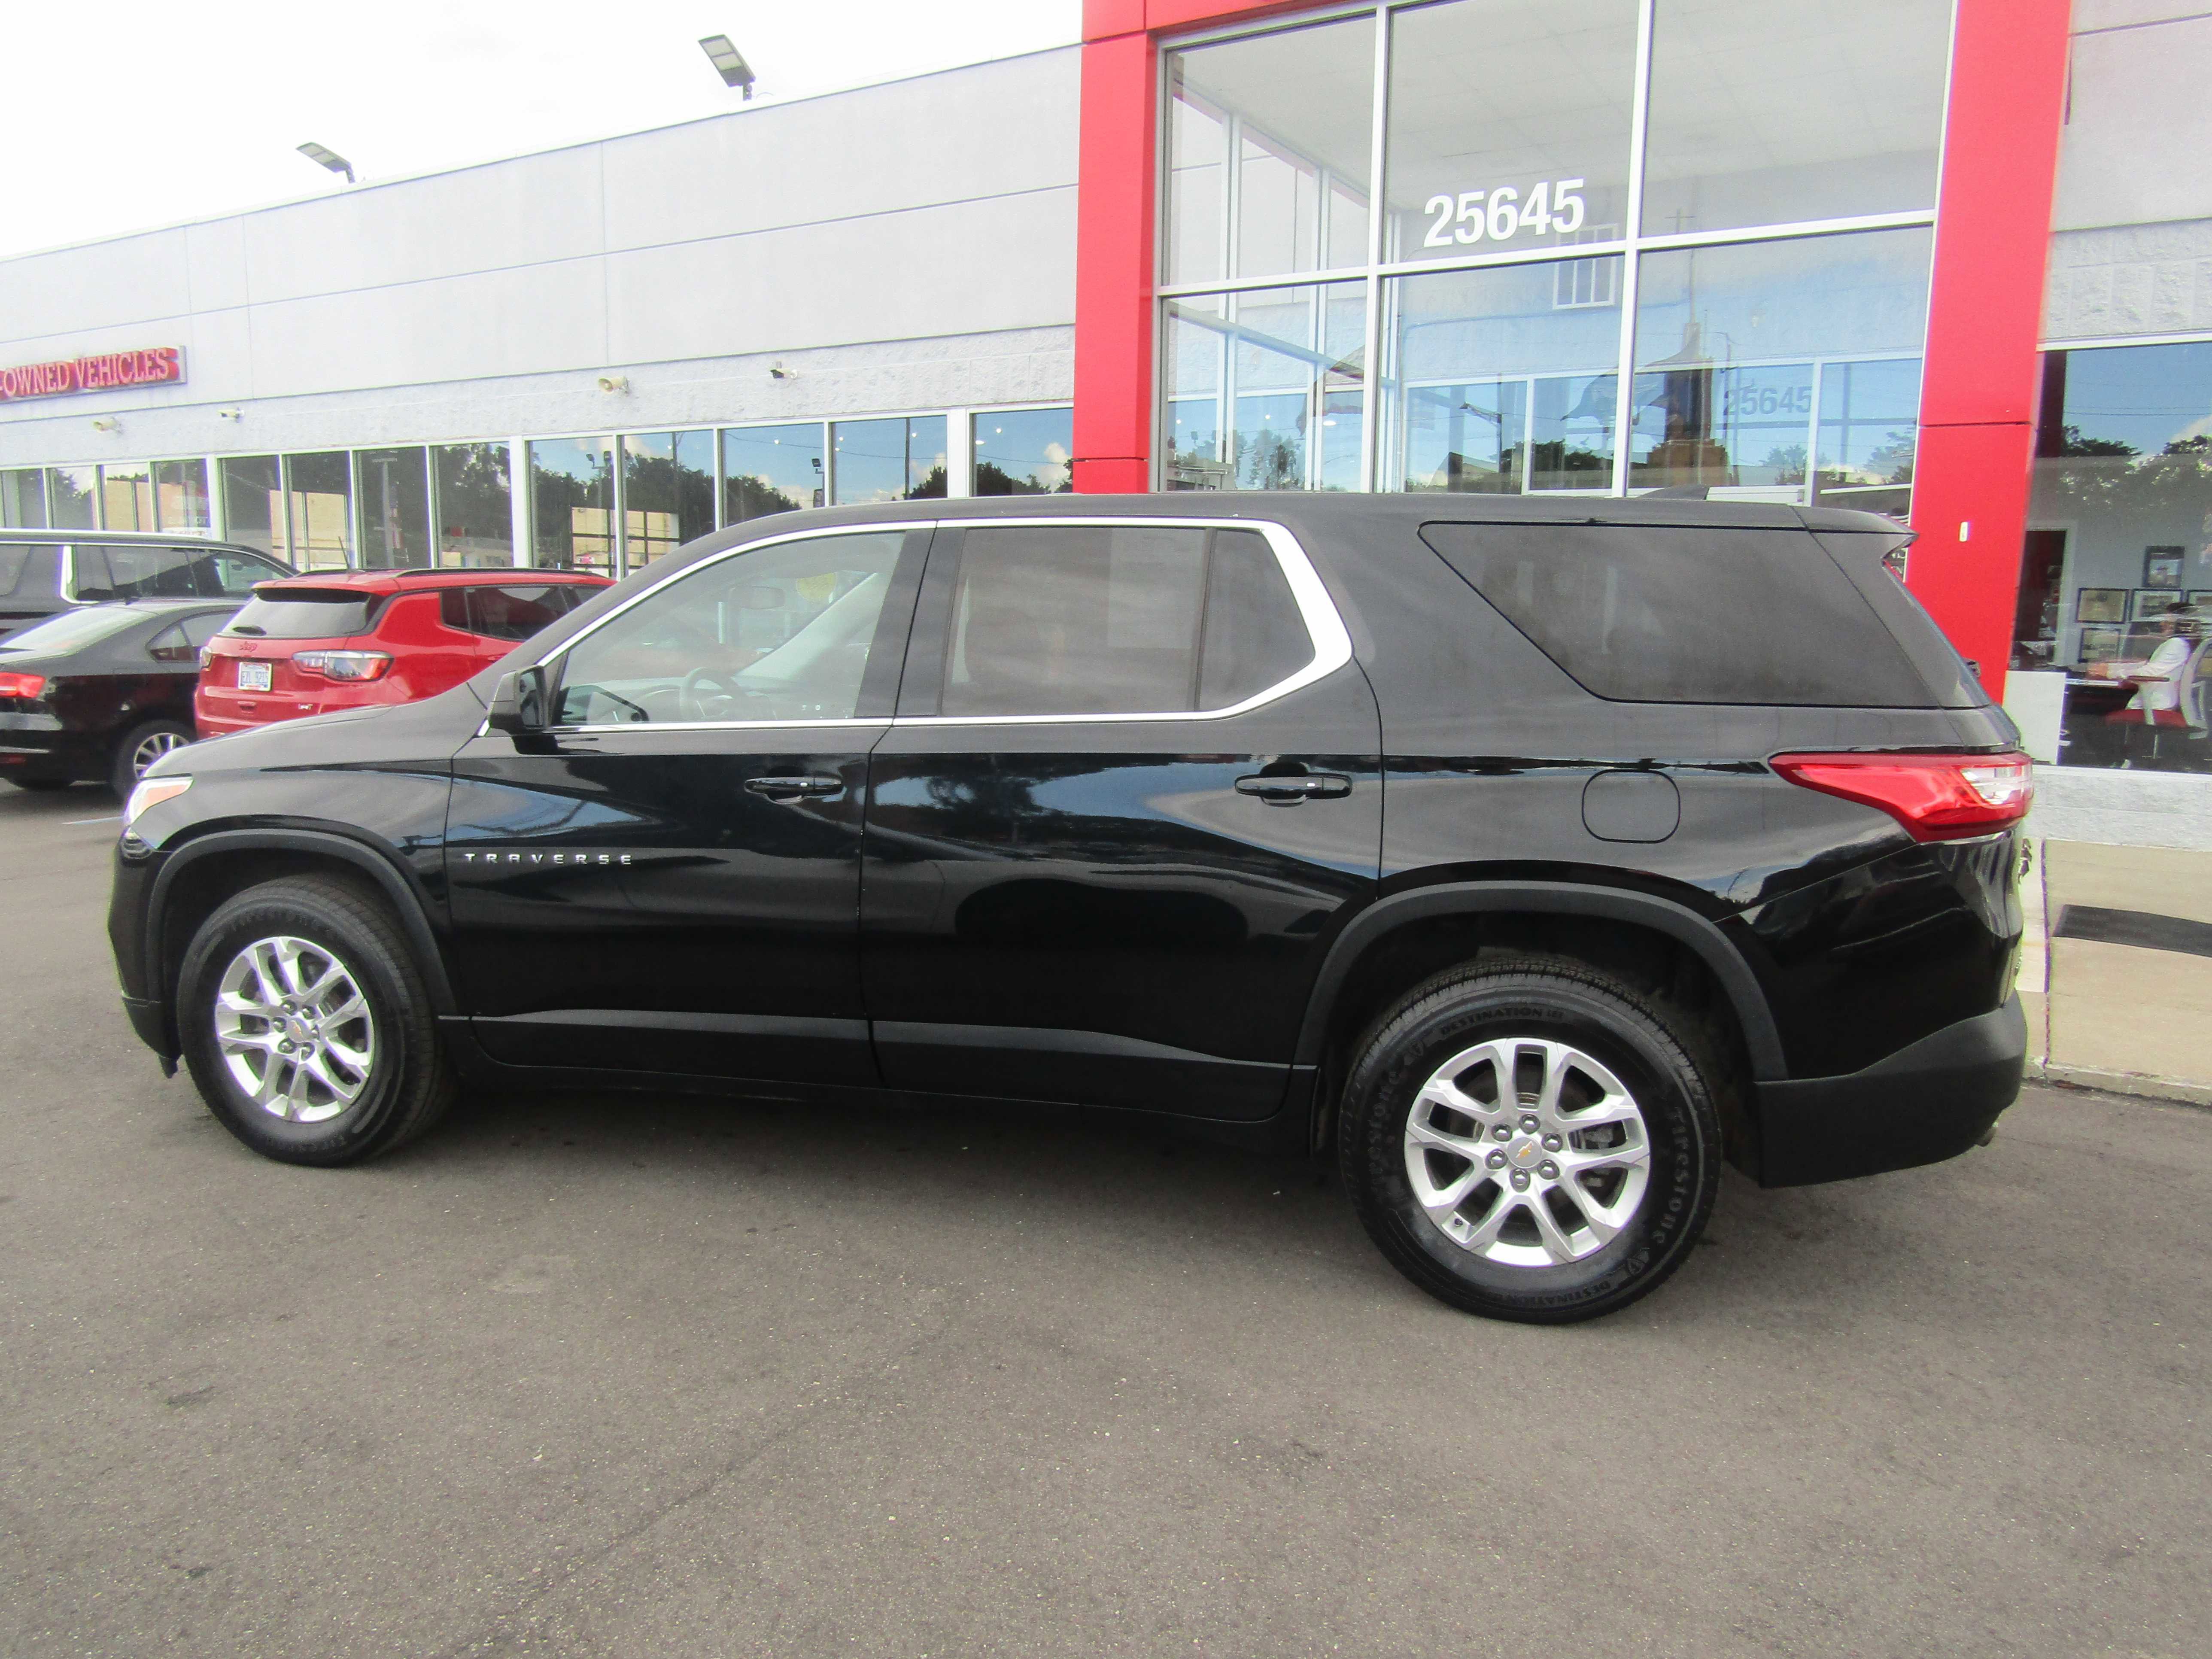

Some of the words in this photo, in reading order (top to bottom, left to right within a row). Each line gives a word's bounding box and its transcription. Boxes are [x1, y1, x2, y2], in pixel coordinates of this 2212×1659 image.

[1423, 179, 1584, 247] 25645
[74, 347, 171, 389] VEHICLES
[465, 853, 632, 865] TRAVERSE
